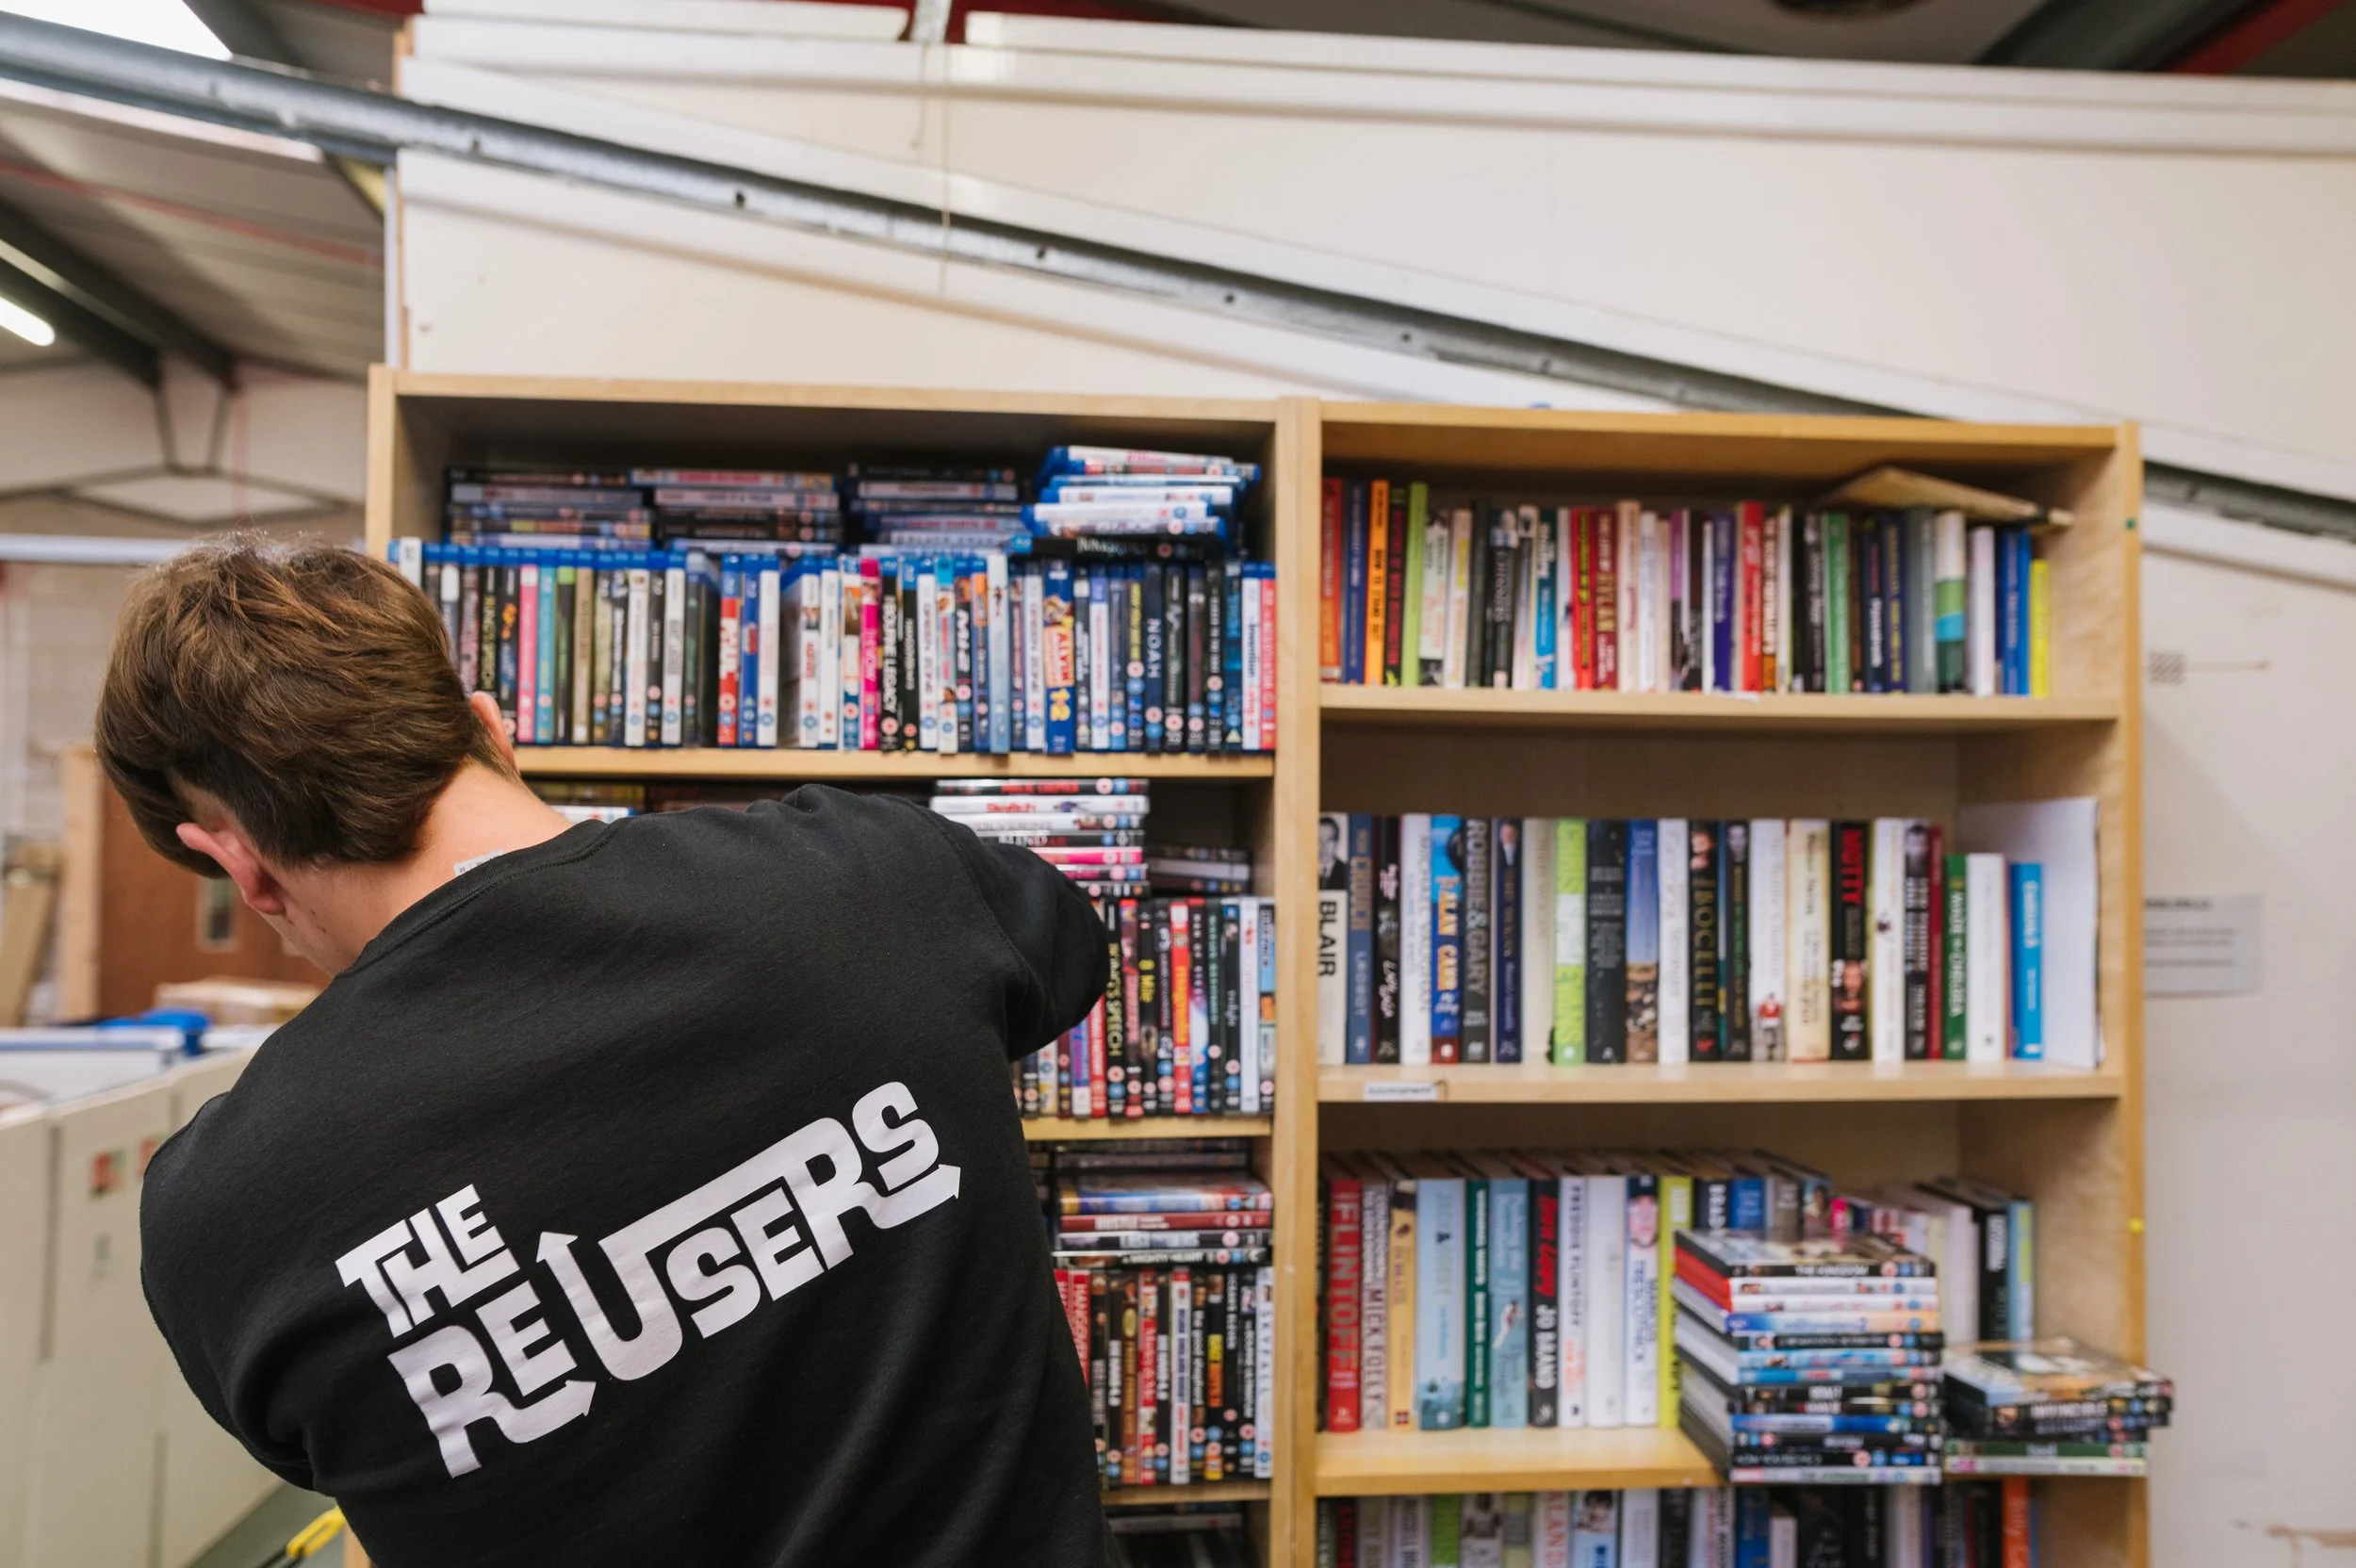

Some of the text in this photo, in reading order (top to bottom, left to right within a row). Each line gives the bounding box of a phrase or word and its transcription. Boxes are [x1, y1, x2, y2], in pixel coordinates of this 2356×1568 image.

[721, 618, 737, 679] PAUL
[883, 603, 896, 713] BOURNE LEGACY
[1147, 618, 1161, 678] NOAH
[1319, 901, 1337, 977] BLAIR
[1438, 890, 1458, 936] ALAN
[1694, 890, 1716, 1006] BOCELLI
[1137, 959, 1154, 1003] 8 Mile
[1172, 966, 1187, 1044] magnolia
[1225, 989, 1237, 1026] twilight
[1107, 1000, 1122, 1056] SPEECH
[335, 1184, 519, 1338] THE
[1435, 1231, 1451, 1244] &
[1569, 1185, 1579, 1328] FREDDIE FLINTOFF
[1226, 1274, 1237, 1349] OCEAN'S ELEVEN
[1332, 1202, 1357, 1368] FLINTOFF
[1366, 1288, 1384, 1335] MICK
[1191, 1310, 1205, 1406] the good shepherd
[1259, 1310, 1271, 1396] SKYFALL
[1535, 1304, 1555, 1389] JO BRAND
